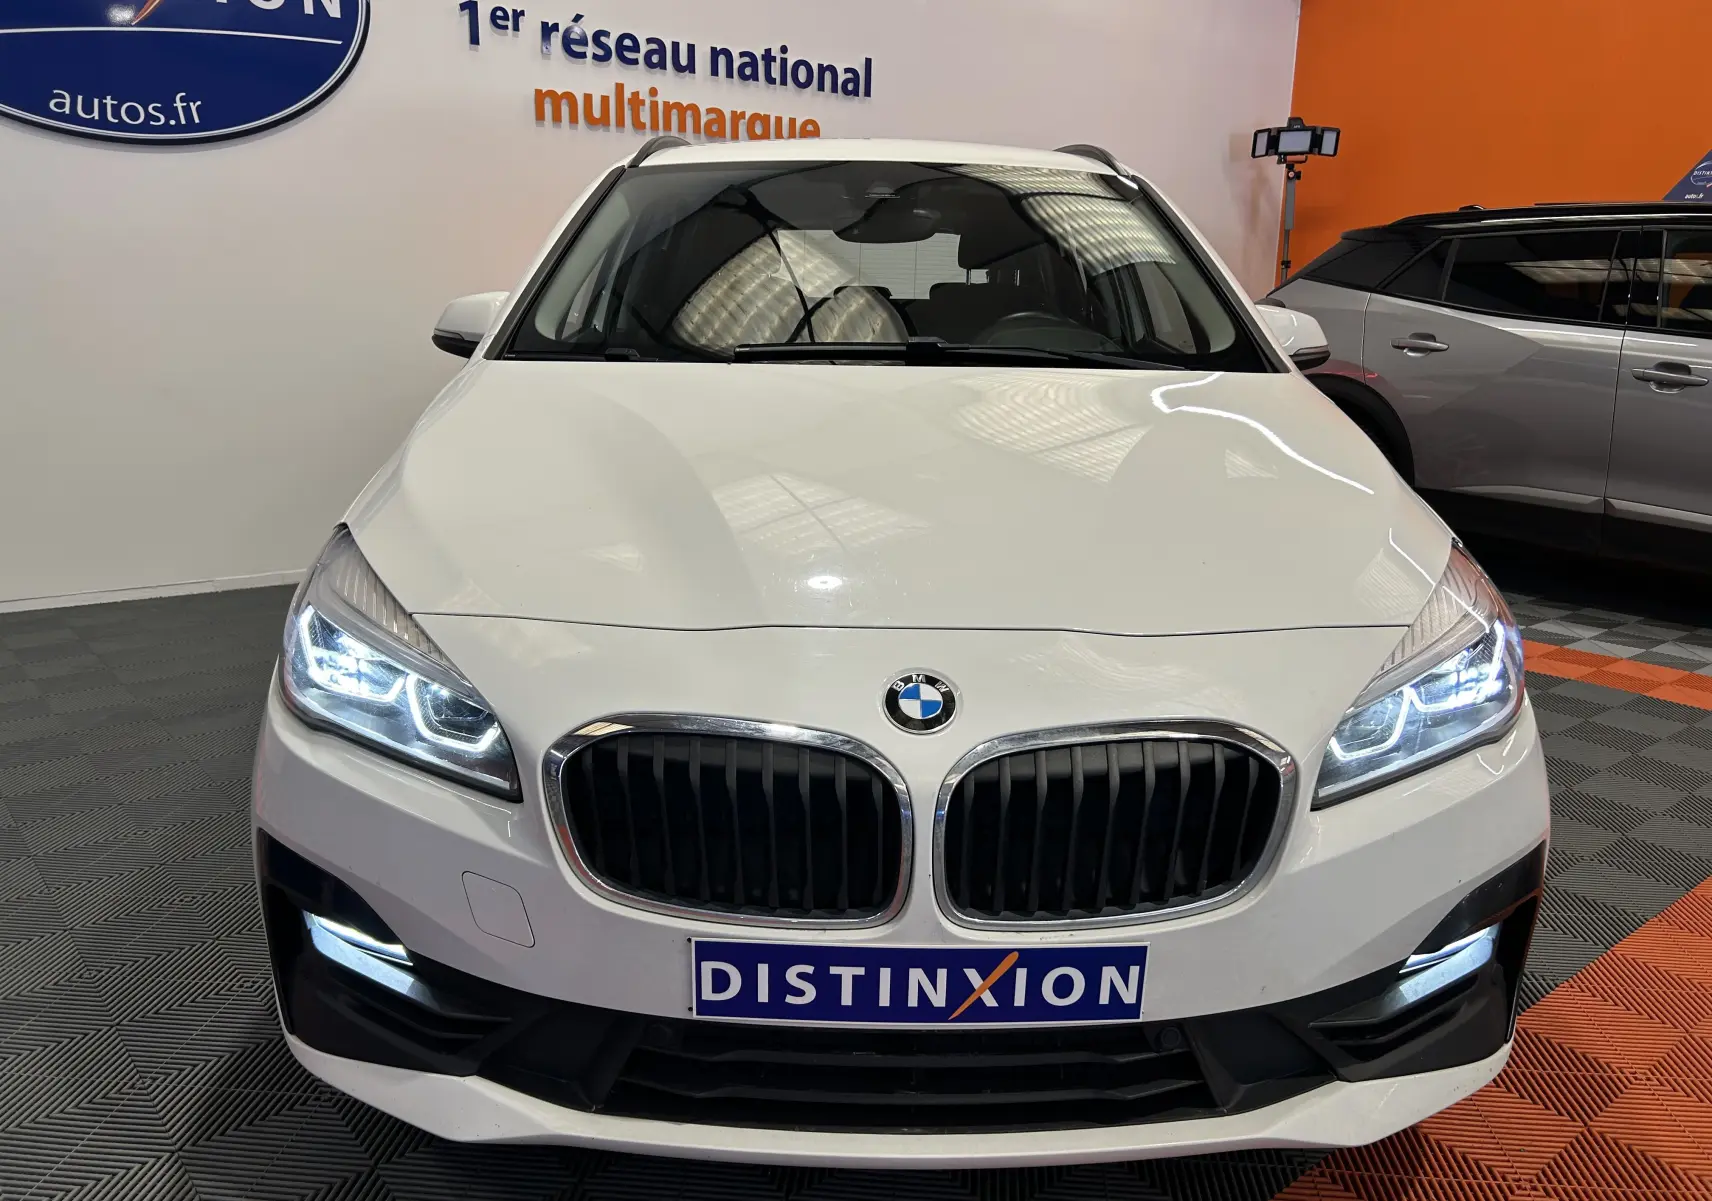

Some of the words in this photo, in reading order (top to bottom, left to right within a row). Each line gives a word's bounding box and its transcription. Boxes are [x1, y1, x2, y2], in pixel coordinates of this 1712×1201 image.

[459, 0, 525, 45] 1er
[541, 13, 696, 74] réseau
[710, 44, 872, 98] national
[48, 89, 202, 125] autos.fr
[535, 82, 820, 140] multimarque
[891, 675, 949, 692] BMW
[701, 951, 1140, 1020] DISTINXION
